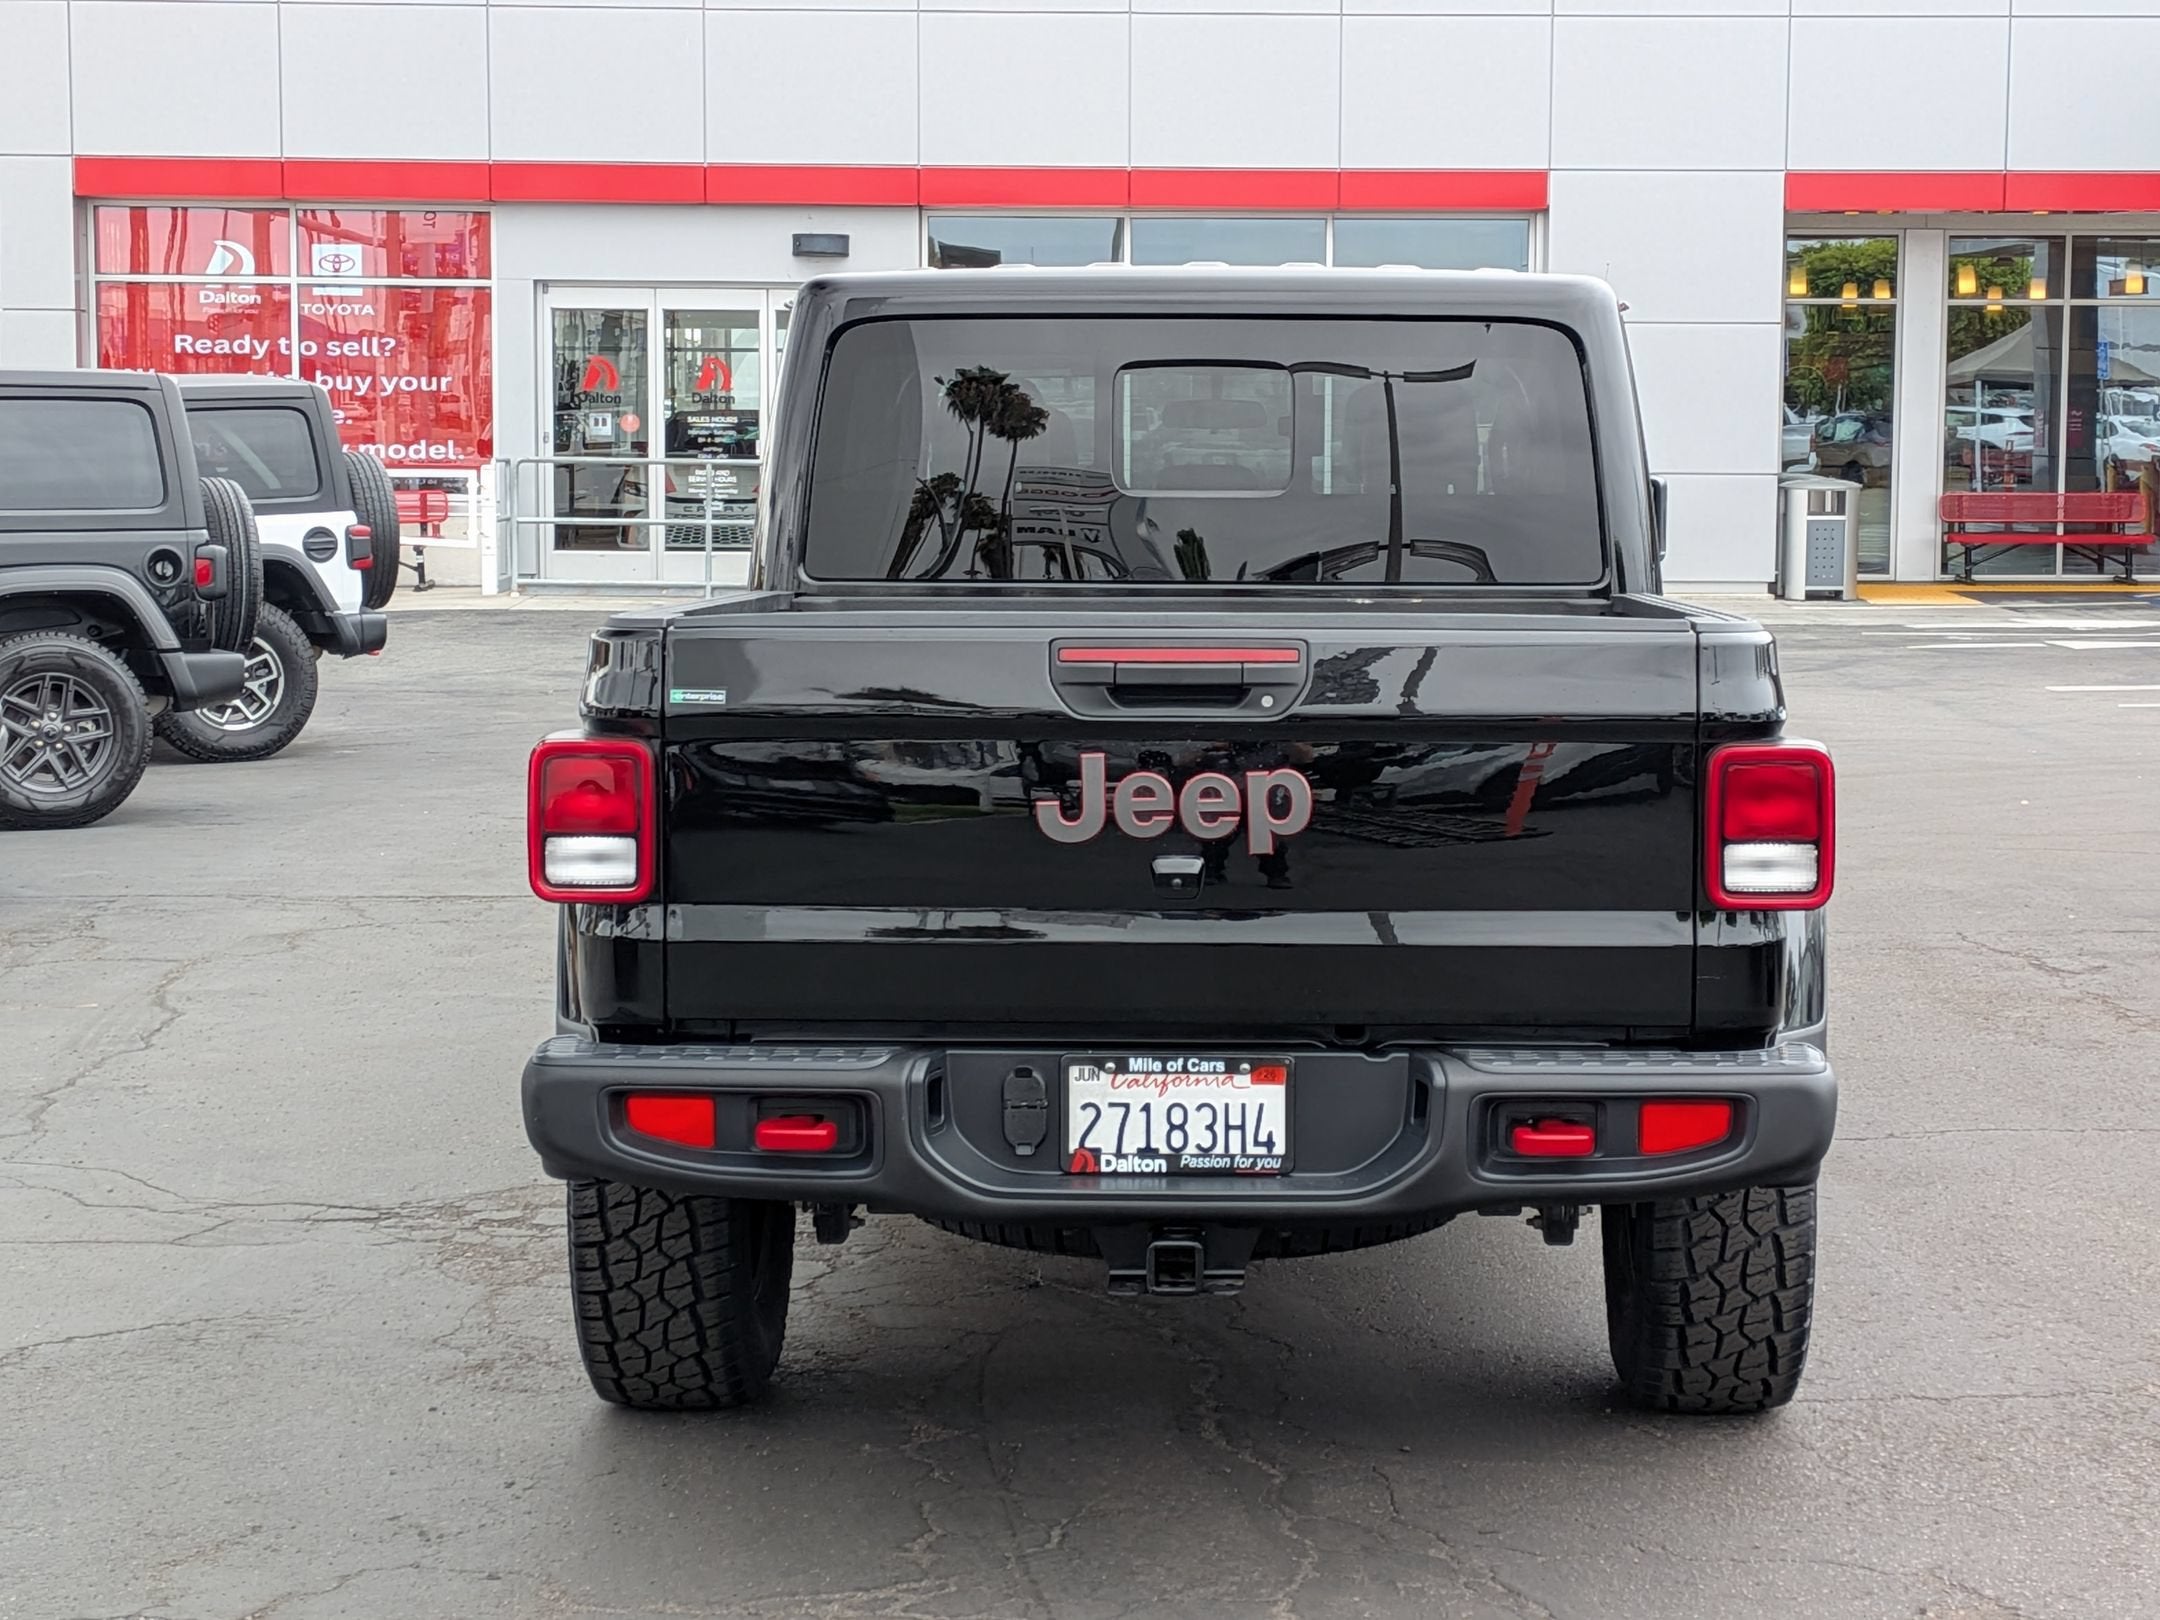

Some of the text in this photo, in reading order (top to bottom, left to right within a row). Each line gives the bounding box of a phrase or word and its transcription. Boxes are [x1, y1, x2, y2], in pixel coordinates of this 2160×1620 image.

[199, 290, 262, 305] Dalton
[300, 303, 376, 316] TOYOTA
[174, 334, 270, 360] Ready
[326, 336, 396, 357] sell?
[315, 370, 373, 396] buy
[380, 375, 453, 397] your
[577, 391, 622, 404] Dalton
[691, 392, 736, 405] Dalton
[357, 439, 466, 461] model.
[1035, 752, 1313, 856] Jeep
[1074, 1066, 1101, 1082] JUN
[1129, 1057, 1226, 1073] Mile of Cars
[1110, 1072, 1250, 1097] California
[1079, 1101, 1277, 1155] 27183H4
[1101, 1154, 1168, 1174] Dalton
[1180, 1154, 1283, 1172] Passion for you
